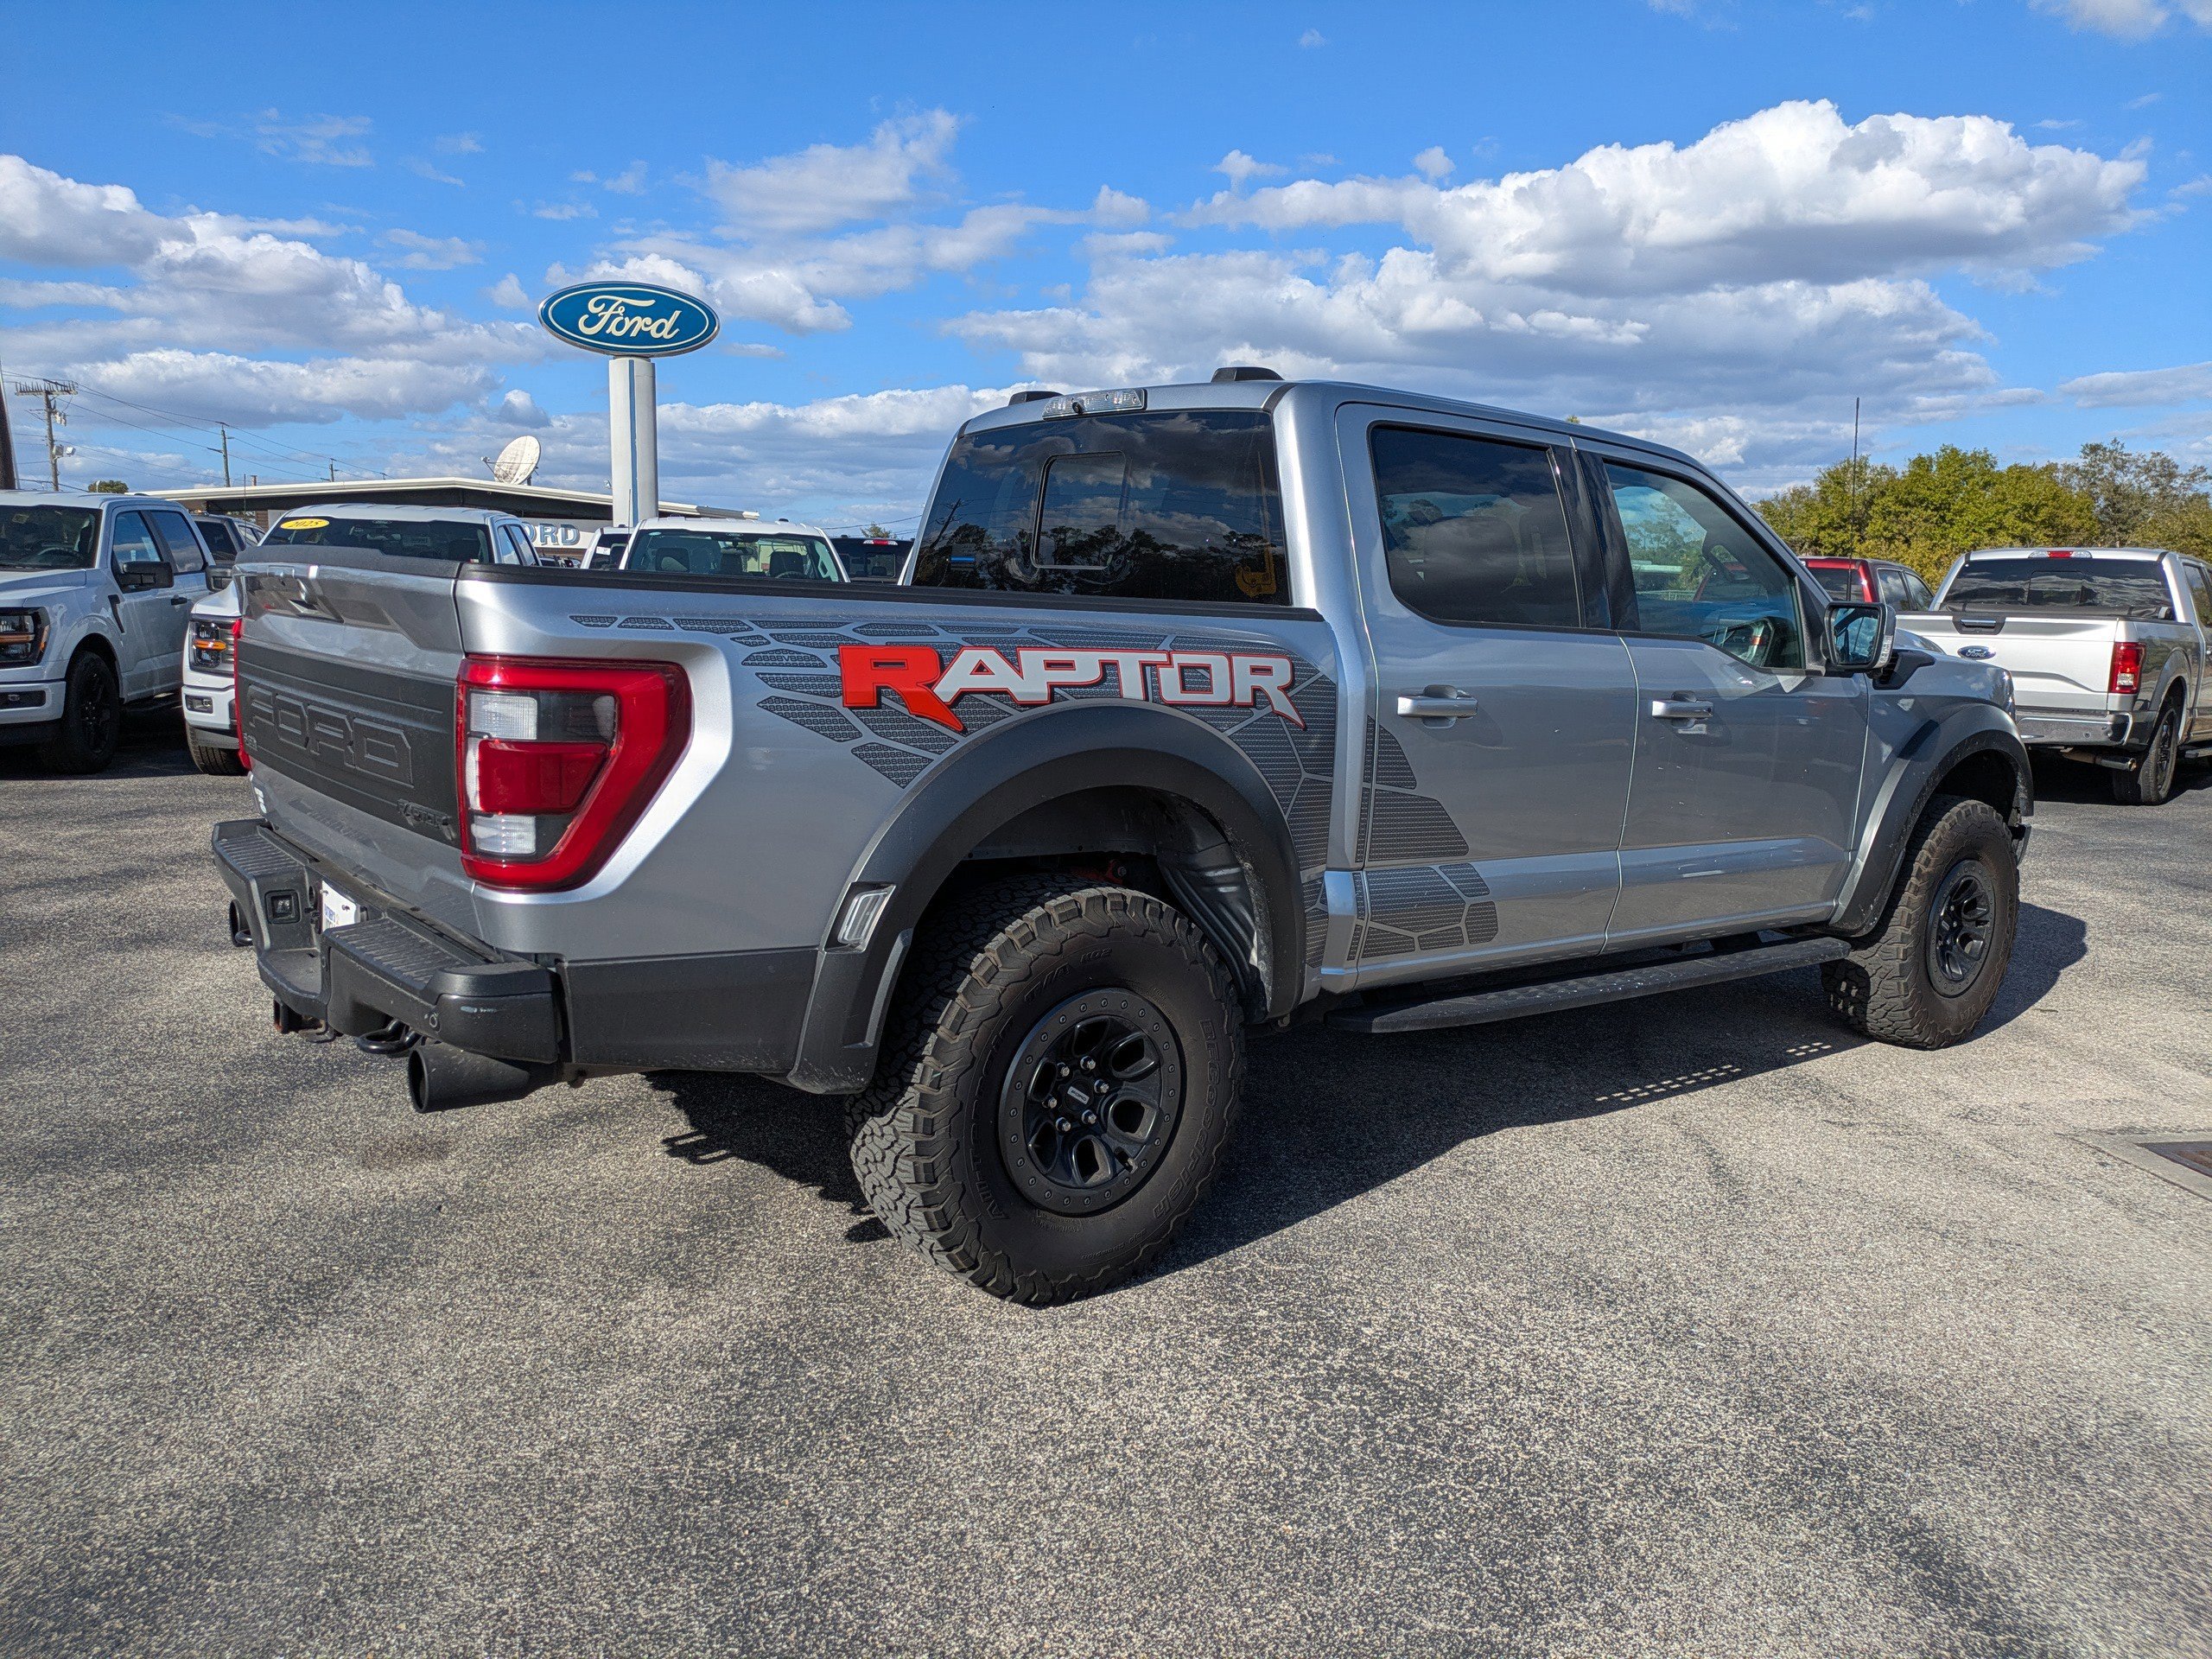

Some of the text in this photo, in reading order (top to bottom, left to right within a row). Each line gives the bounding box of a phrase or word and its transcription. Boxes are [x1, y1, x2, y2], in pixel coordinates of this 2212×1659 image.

[578, 295, 683, 340] Ford
[1966, 648, 1986, 658] Ford
[838, 645, 1307, 732] RAPTOR
[247, 683, 415, 789] FORD
[1071, 1090, 1087, 1102] FORD
[1153, 1018, 1220, 1219] BFGoodrich
